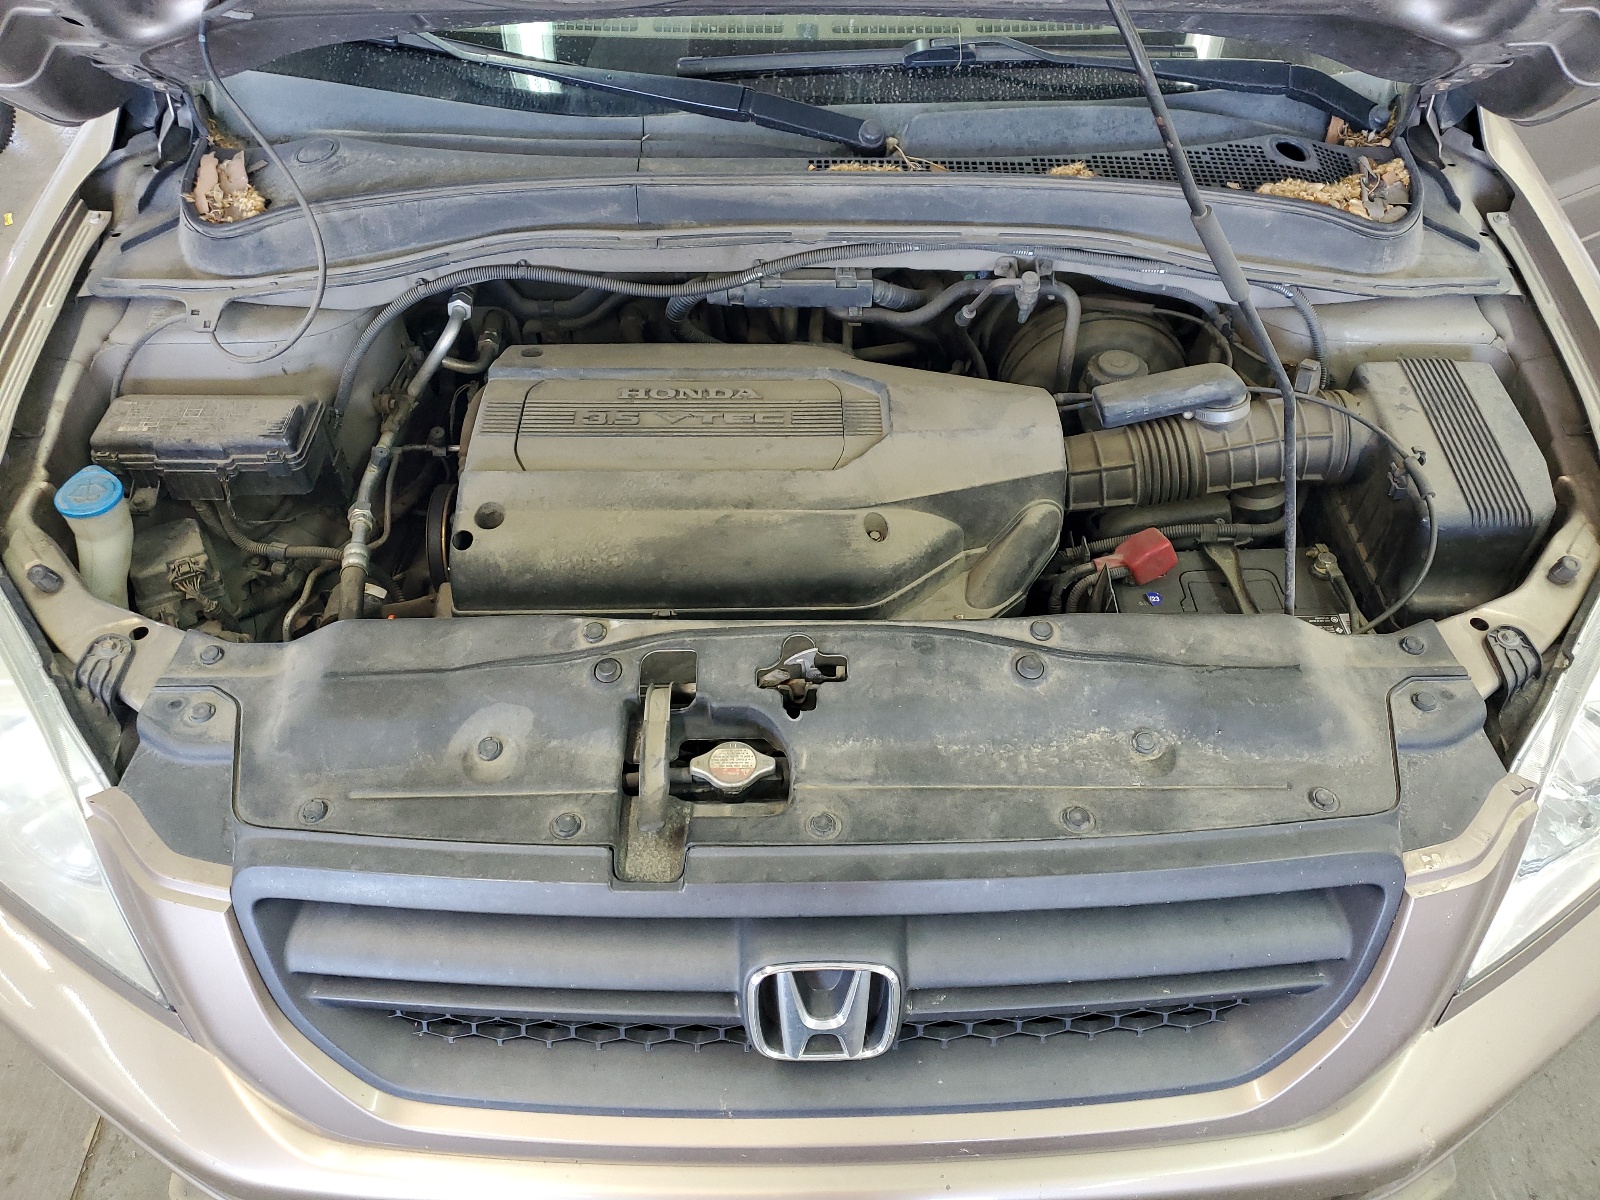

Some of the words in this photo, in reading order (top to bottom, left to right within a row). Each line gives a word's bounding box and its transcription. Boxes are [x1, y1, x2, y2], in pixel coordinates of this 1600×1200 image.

[618, 387, 763, 400] HONDA
[582, 411, 640, 426] 3.5
[650, 411, 785, 425] VTEC
